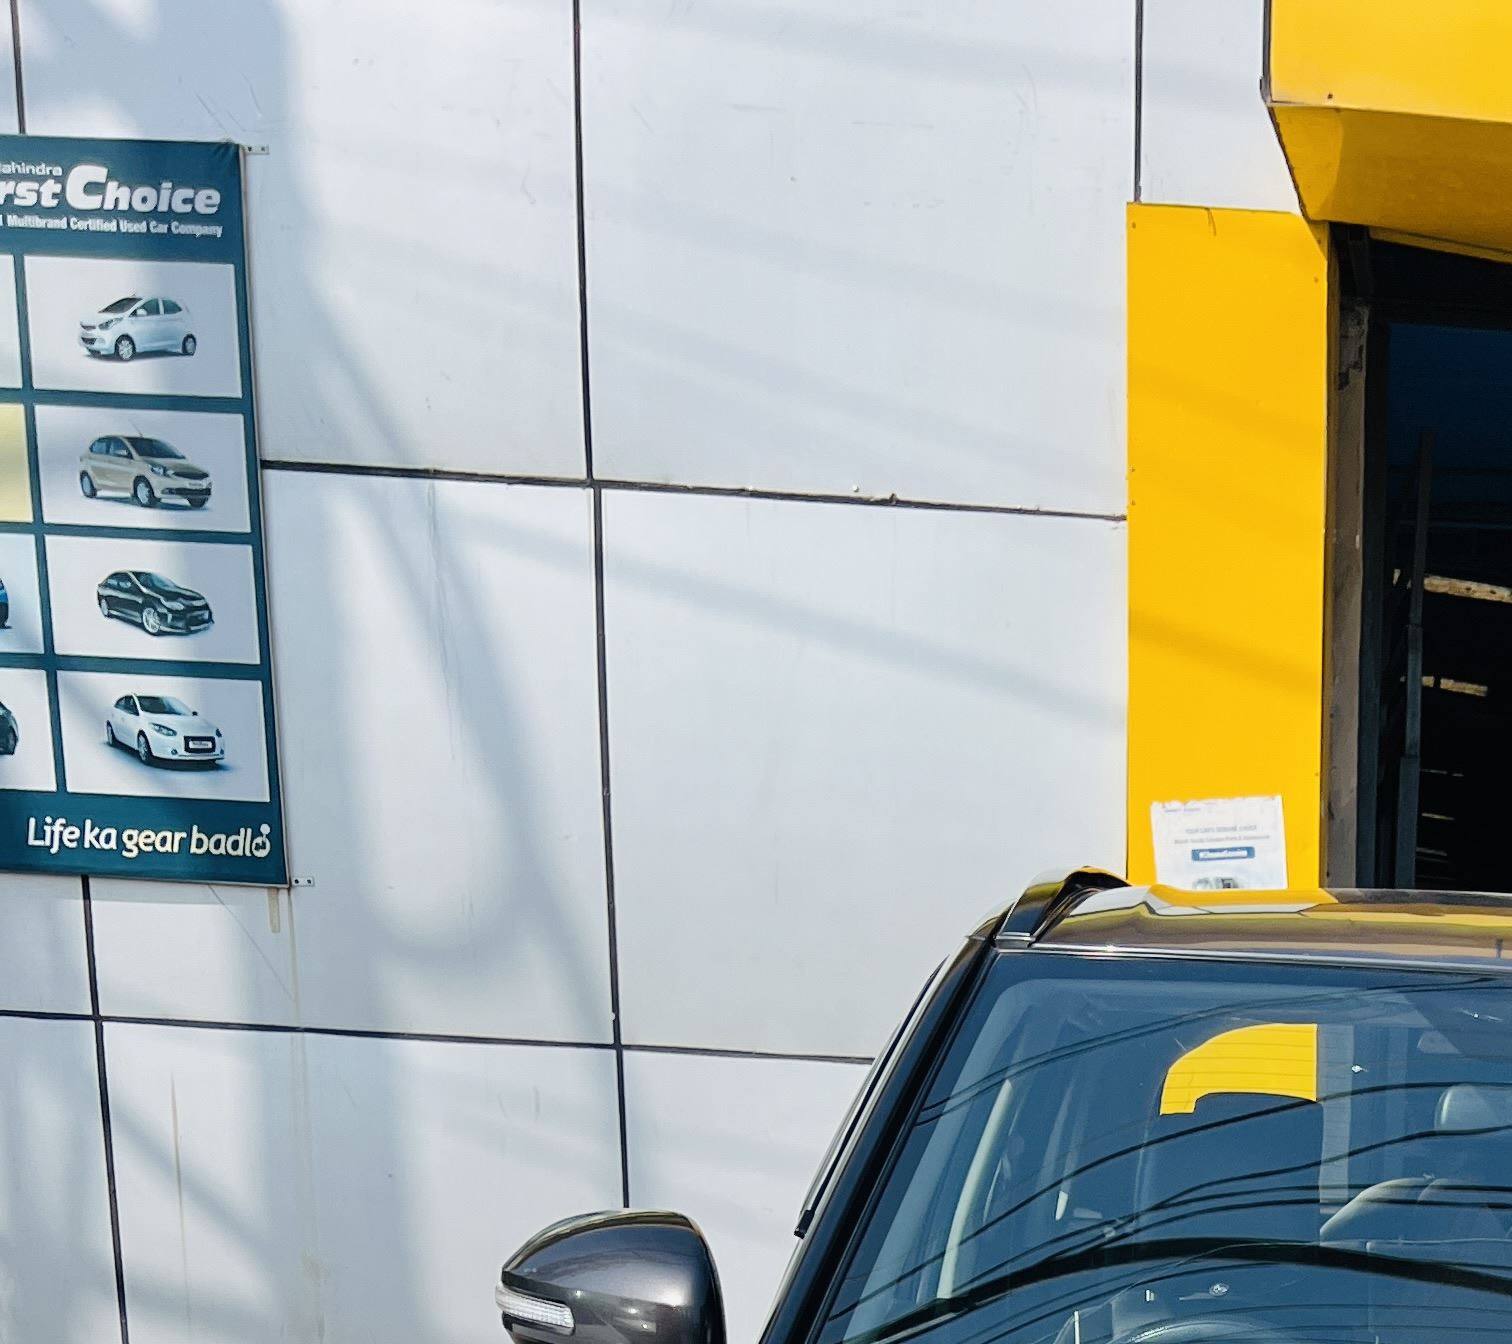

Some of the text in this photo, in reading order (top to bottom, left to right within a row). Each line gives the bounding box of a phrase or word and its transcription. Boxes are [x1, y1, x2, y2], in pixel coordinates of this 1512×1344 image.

[0, 161, 63, 177] ahindra
[0, 164, 221, 215] rst Choice
[7, 214, 67, 230] Multibrand
[70, 217, 117, 232] Certified
[120, 220, 147, 233] Used
[150, 221, 168, 233] Car
[171, 222, 223, 238] Company
[27, 816, 81, 855] Life
[83, 819, 118, 850] ka
[121, 828, 188, 858] gear
